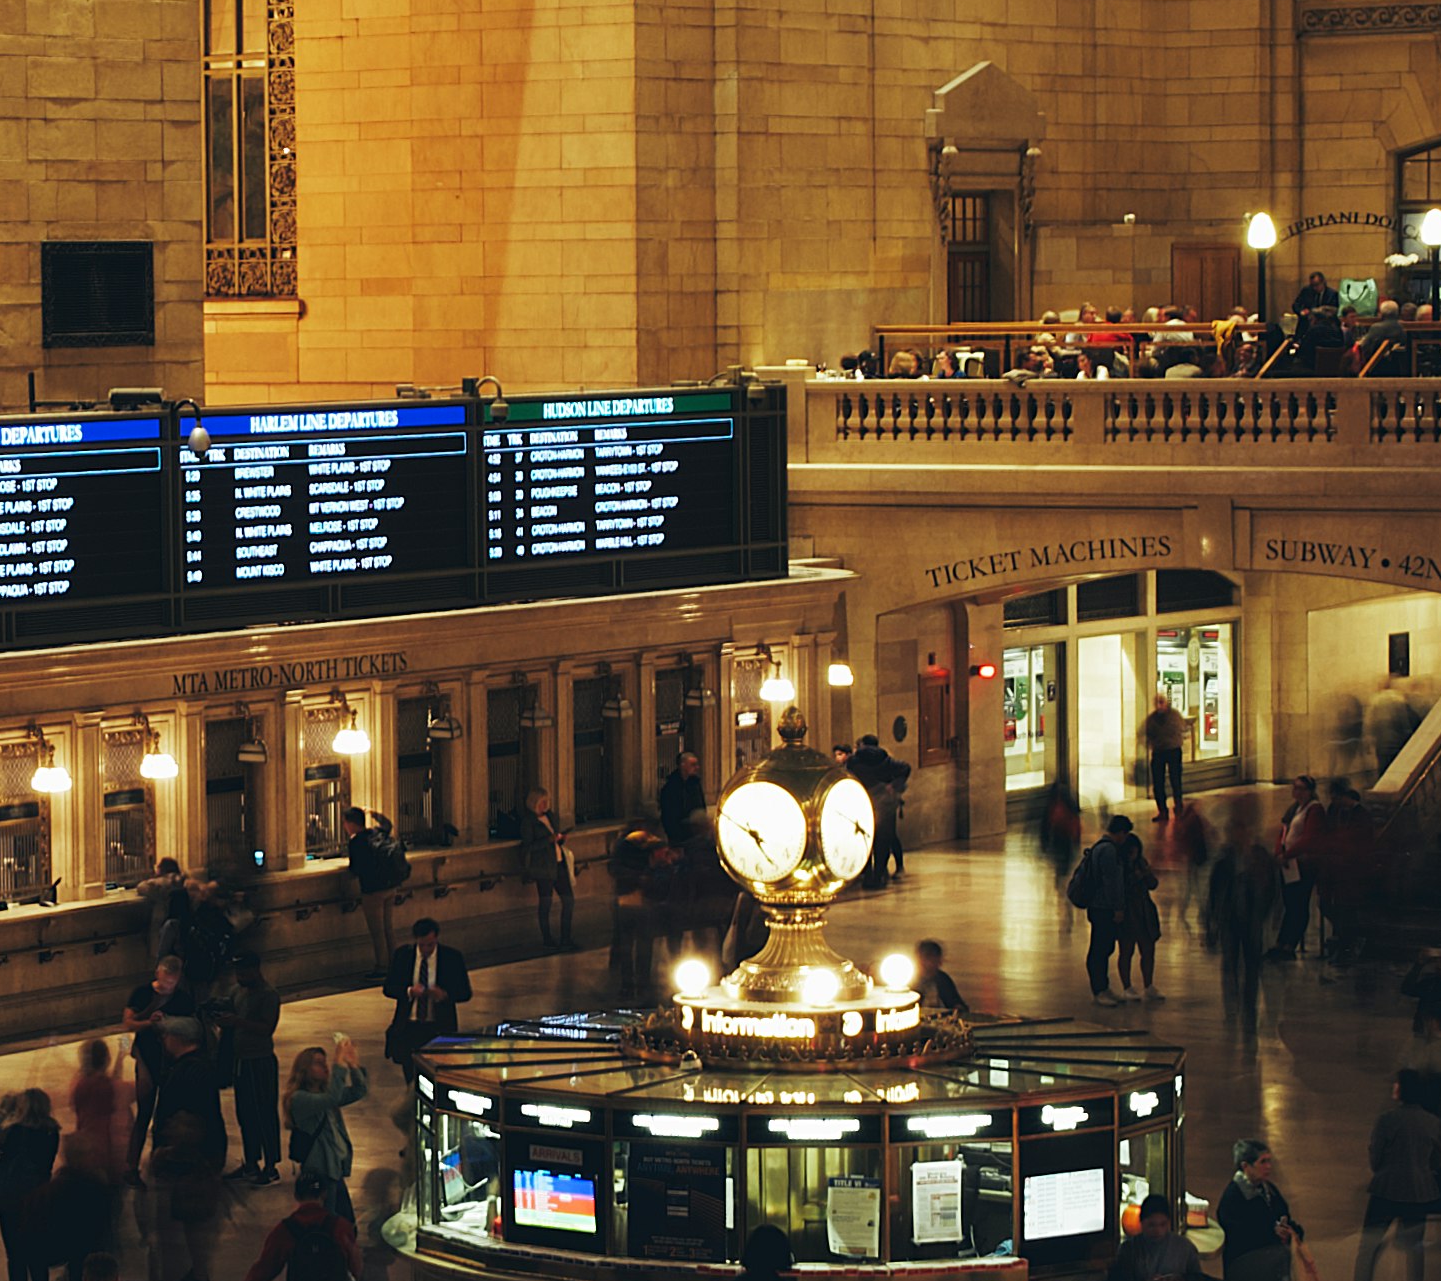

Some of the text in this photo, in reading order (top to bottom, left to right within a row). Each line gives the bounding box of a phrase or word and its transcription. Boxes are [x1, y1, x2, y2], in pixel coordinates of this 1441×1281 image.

[544, 397, 673, 418] HUDSON LINE DEPARTURES
[251, 410, 398, 433] HARLEM LINE DEPARTURES
[1, 425, 82, 445] DEPARTURES
[22, 479, 35, 491] 1ST
[37, 478, 57, 492] STOP
[5, 500, 32, 513] PLAINS
[38, 499, 52, 512] 1ST
[53, 498, 73, 511] STOP
[31, 520, 45, 533] 1ST
[46, 519, 66, 532] STOP
[925, 535, 1171, 588] TICKET MACHINES
[1265, 539, 1377, 569] SUBWAY
[172, 652, 407, 695] MTA METRO-NORTH TICKETS
[702, 1009, 815, 1038] Information
[533, 1147, 580, 1162] ARRIVALS
